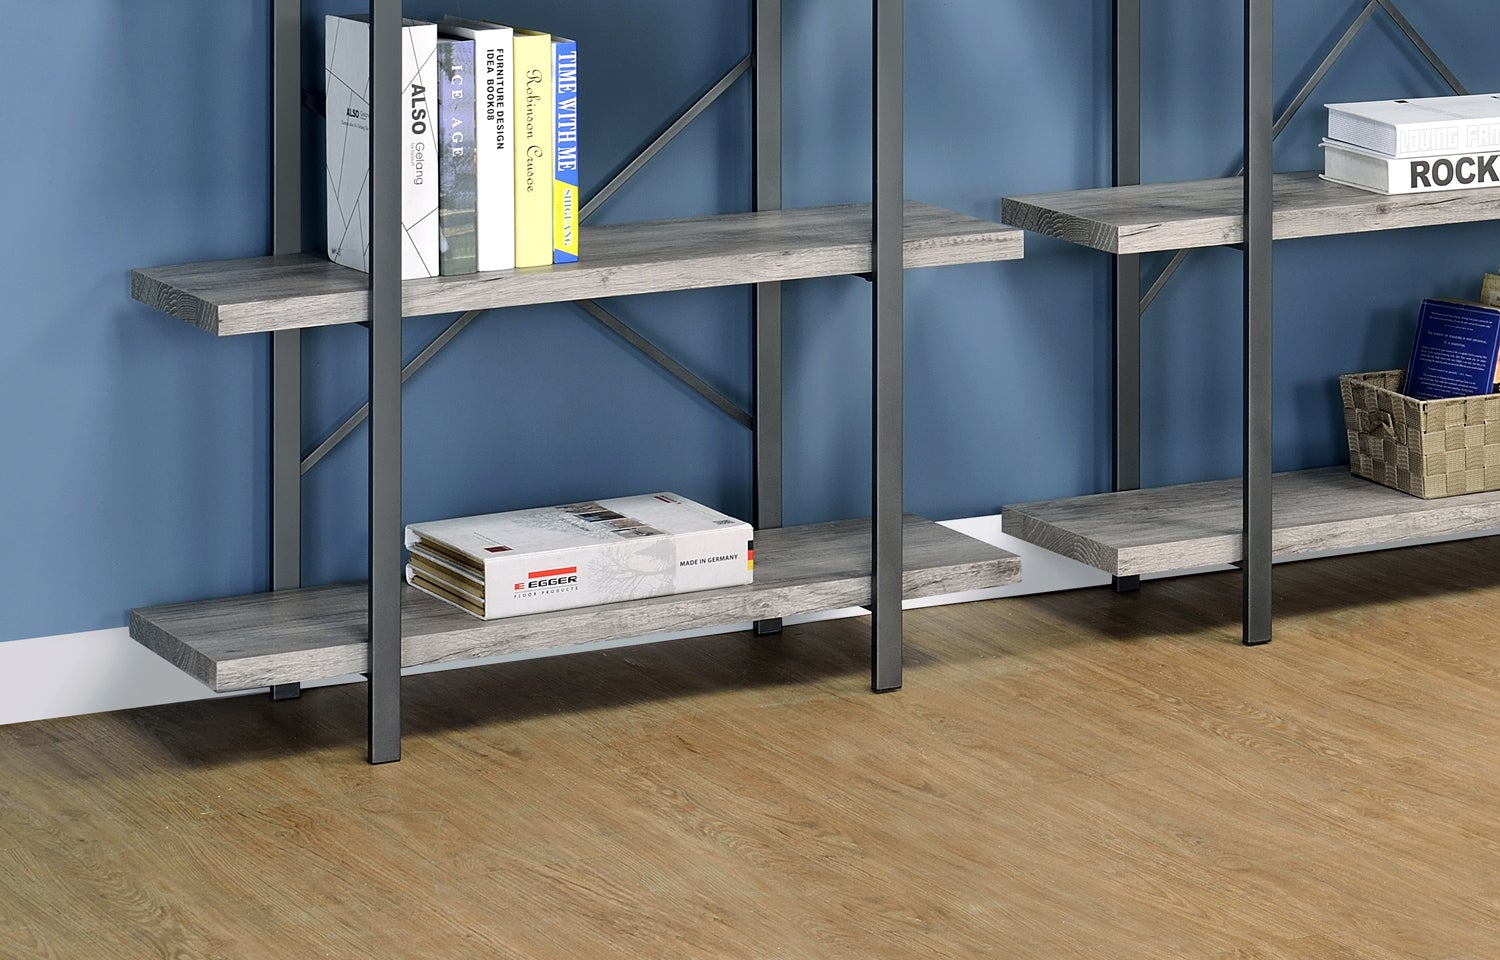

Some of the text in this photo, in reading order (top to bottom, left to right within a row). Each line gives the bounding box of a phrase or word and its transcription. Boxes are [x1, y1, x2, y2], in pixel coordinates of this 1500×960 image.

[346, 107, 360, 118] ALSO
[451, 65, 464, 157] ICE AGE
[486, 49, 495, 121] IDEA BOOK08
[496, 48, 504, 150] FURNITURE DESIGN
[557, 50, 577, 172] TIME WITH ME
[411, 84, 427, 186] ALSO Gelang
[525, 69, 543, 193] Robinson Crusoe
[528, 575, 578, 589] EGGER
[541, 586, 578, 595] PRODUCTS
[680, 554, 739, 567] MADE IN GERMANY
